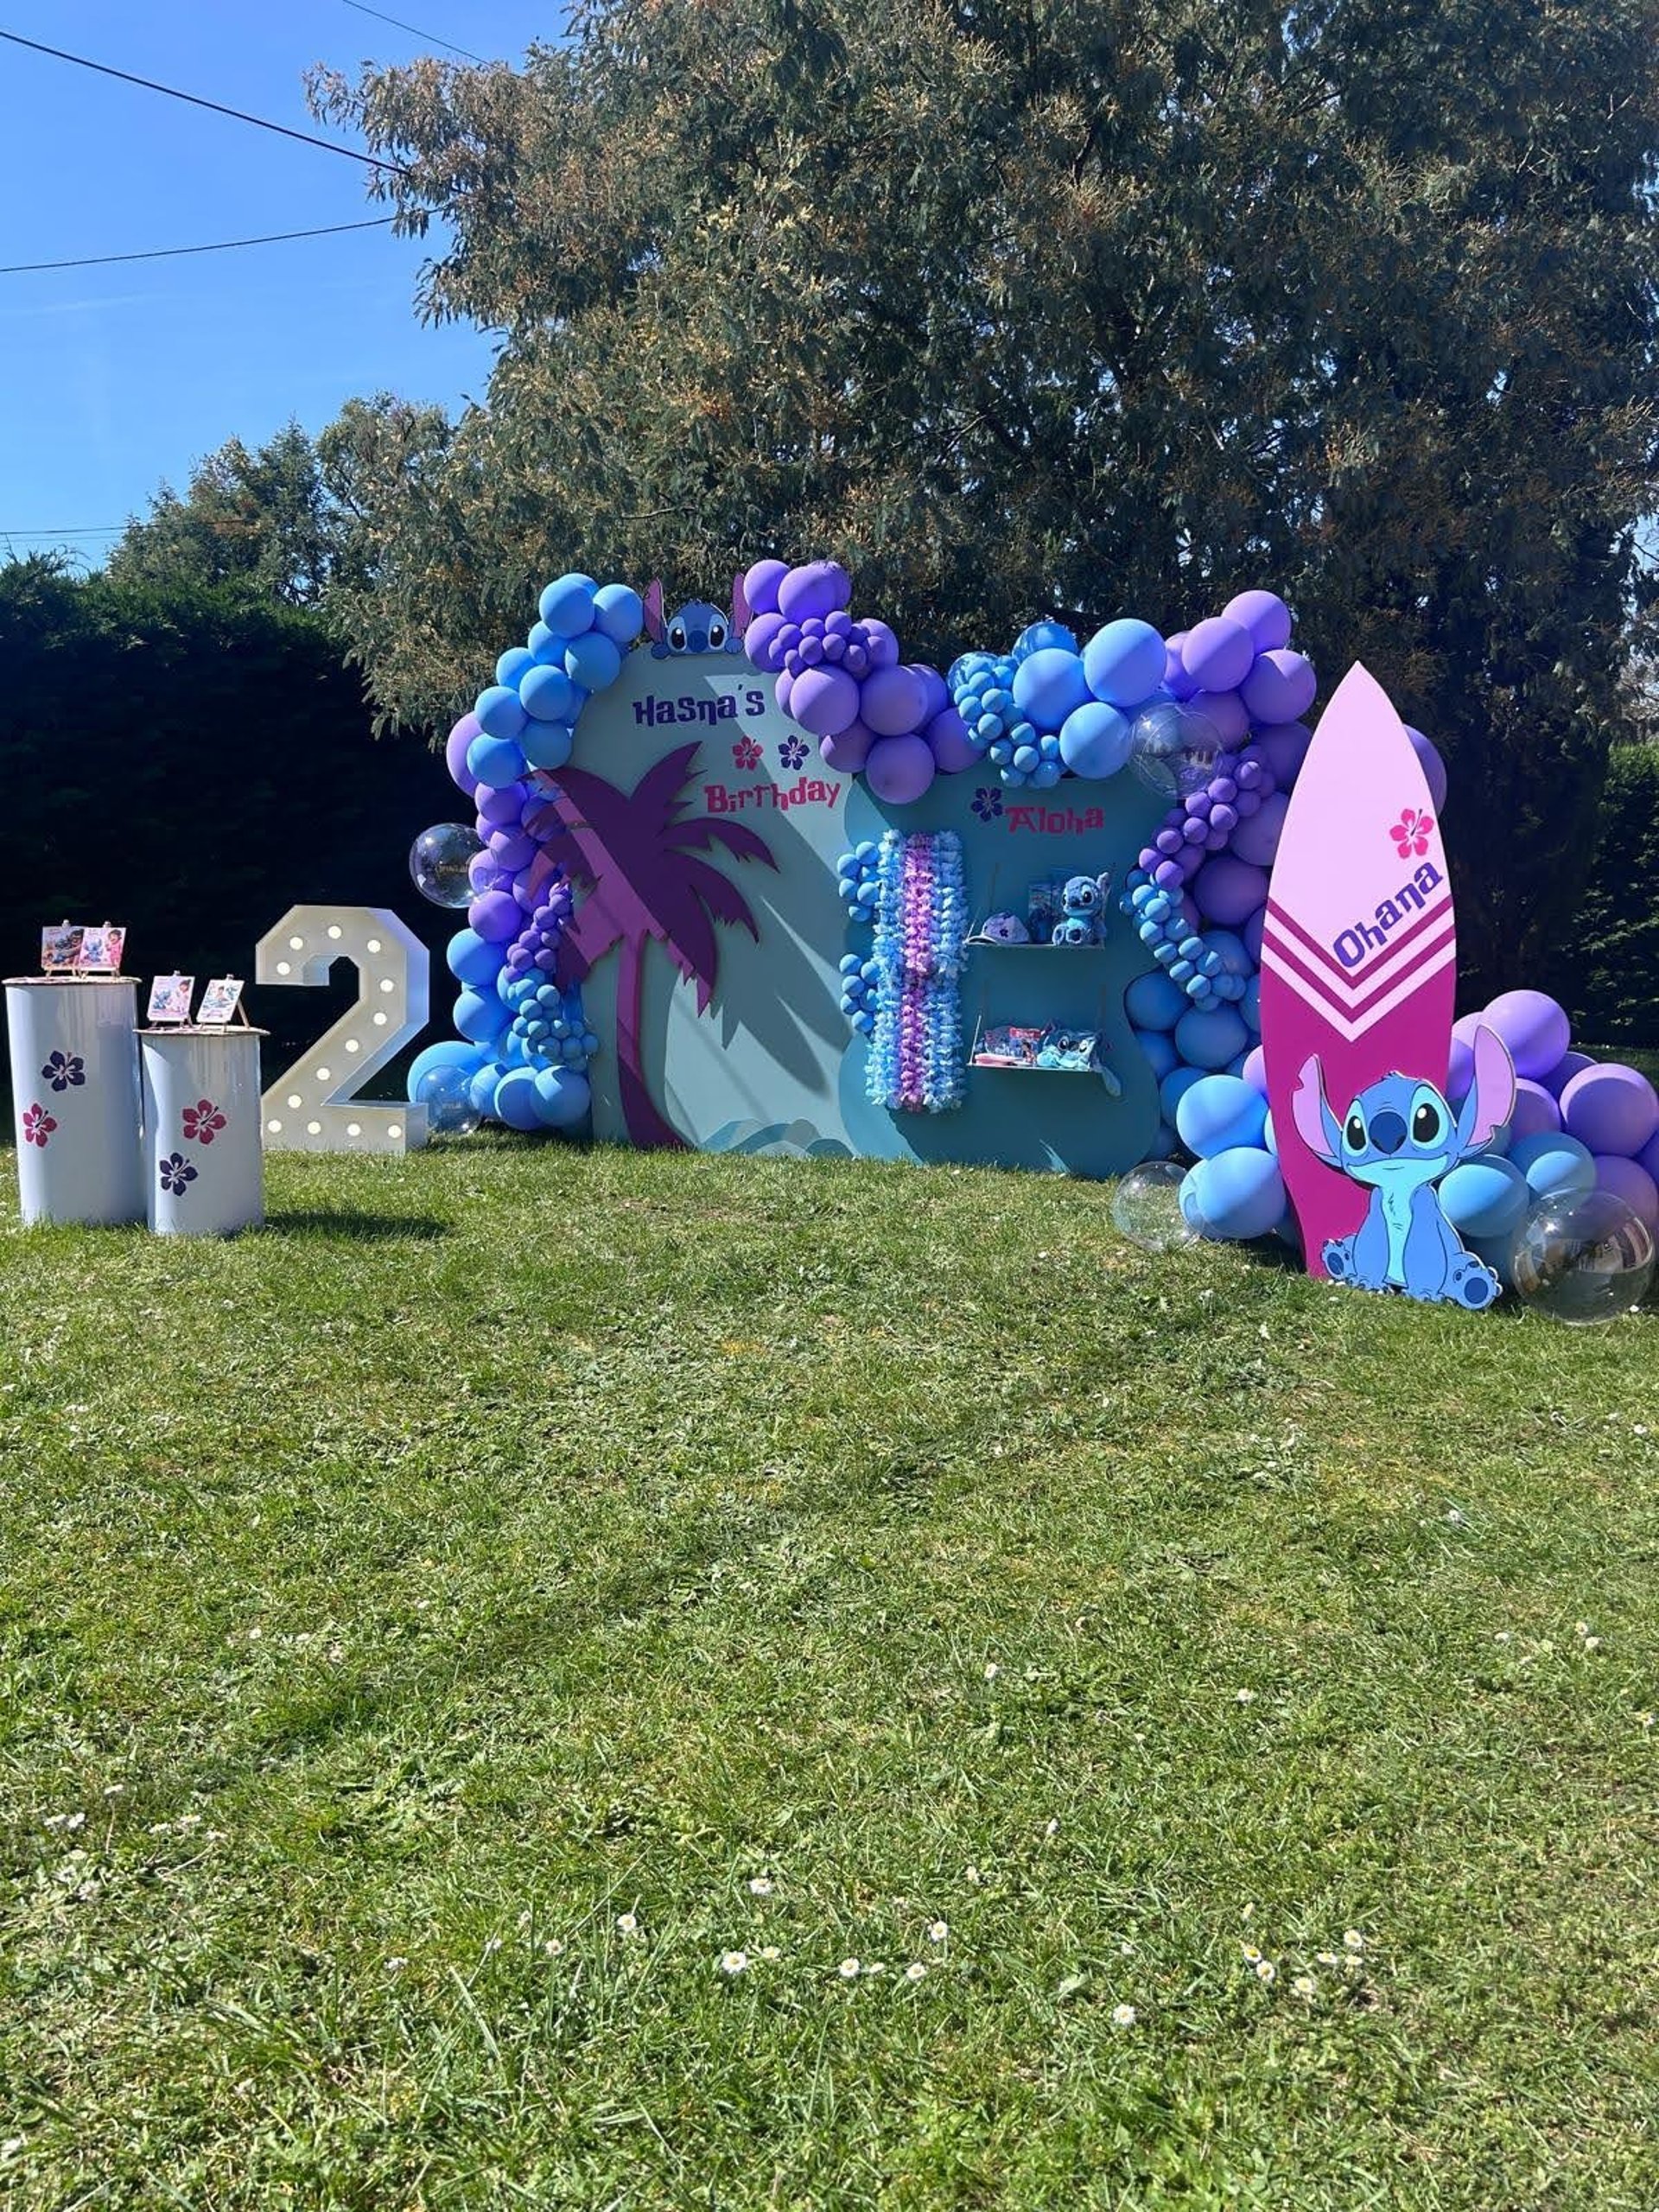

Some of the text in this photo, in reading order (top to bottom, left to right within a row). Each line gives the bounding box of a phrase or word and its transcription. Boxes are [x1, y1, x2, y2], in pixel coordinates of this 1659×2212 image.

[632, 684, 765, 726] Hasna's
[704, 777, 841, 813] Birthday
[1005, 806, 1104, 836] Aloha
[1332, 862, 1443, 968] Ohana
[256, 905, 430, 1154] 2
